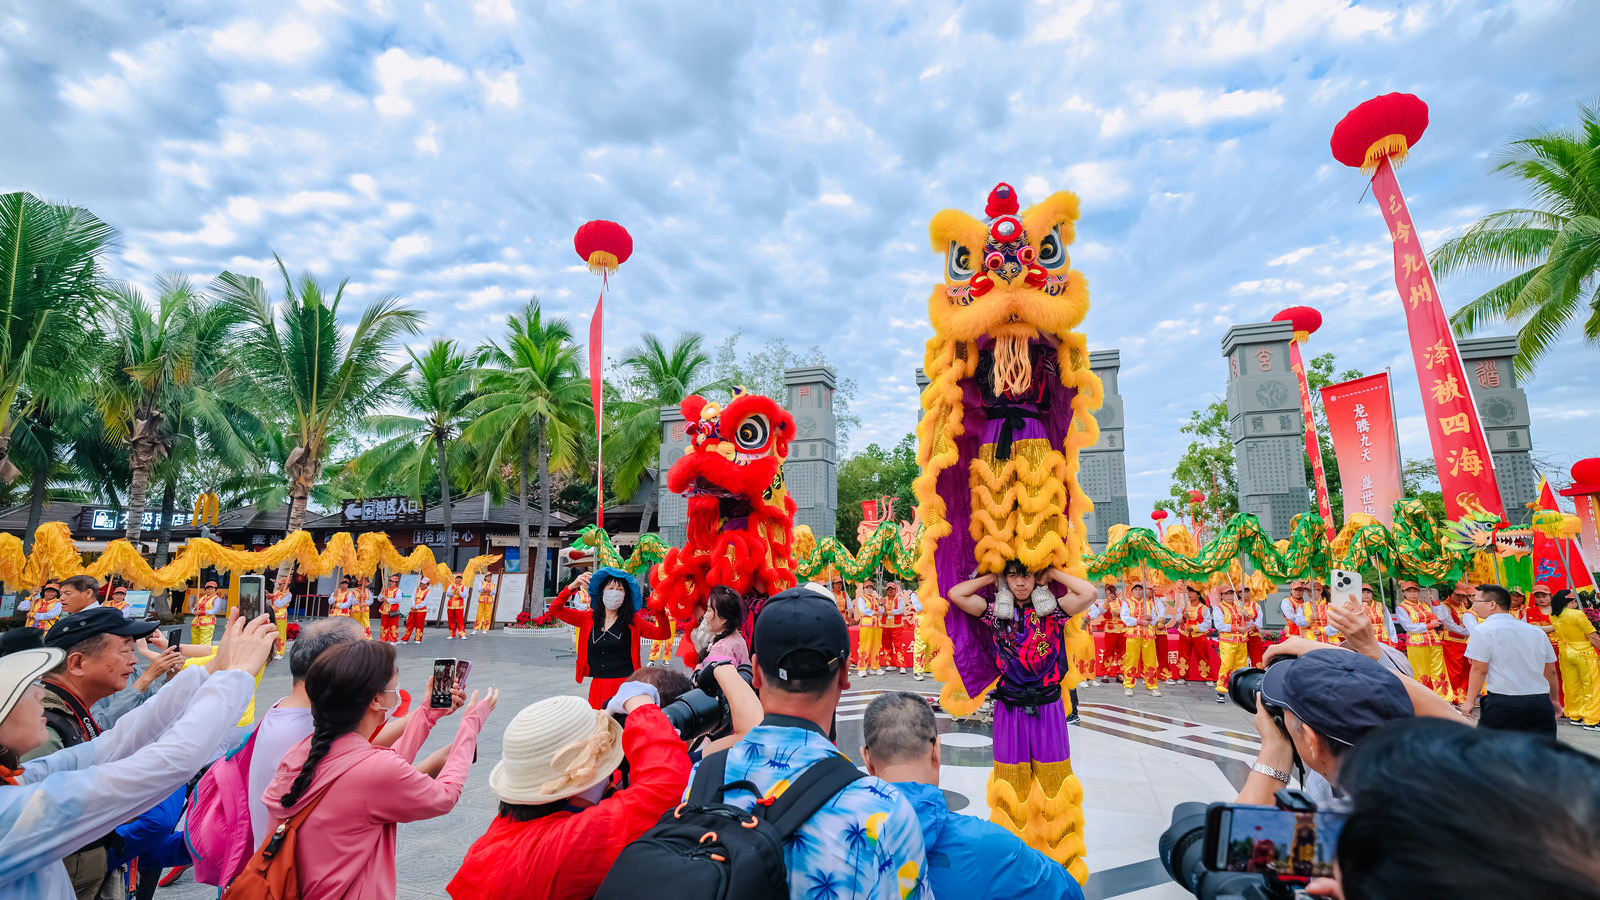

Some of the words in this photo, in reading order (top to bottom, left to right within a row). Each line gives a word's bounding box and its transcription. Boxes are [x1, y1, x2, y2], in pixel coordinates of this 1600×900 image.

[1423, 339, 1484, 477] 泽被四海
[1353, 403, 1372, 464] 龙腾九天
[376, 500, 418, 515] 景区入口
[424, 530, 474, 543] 咨询中心
